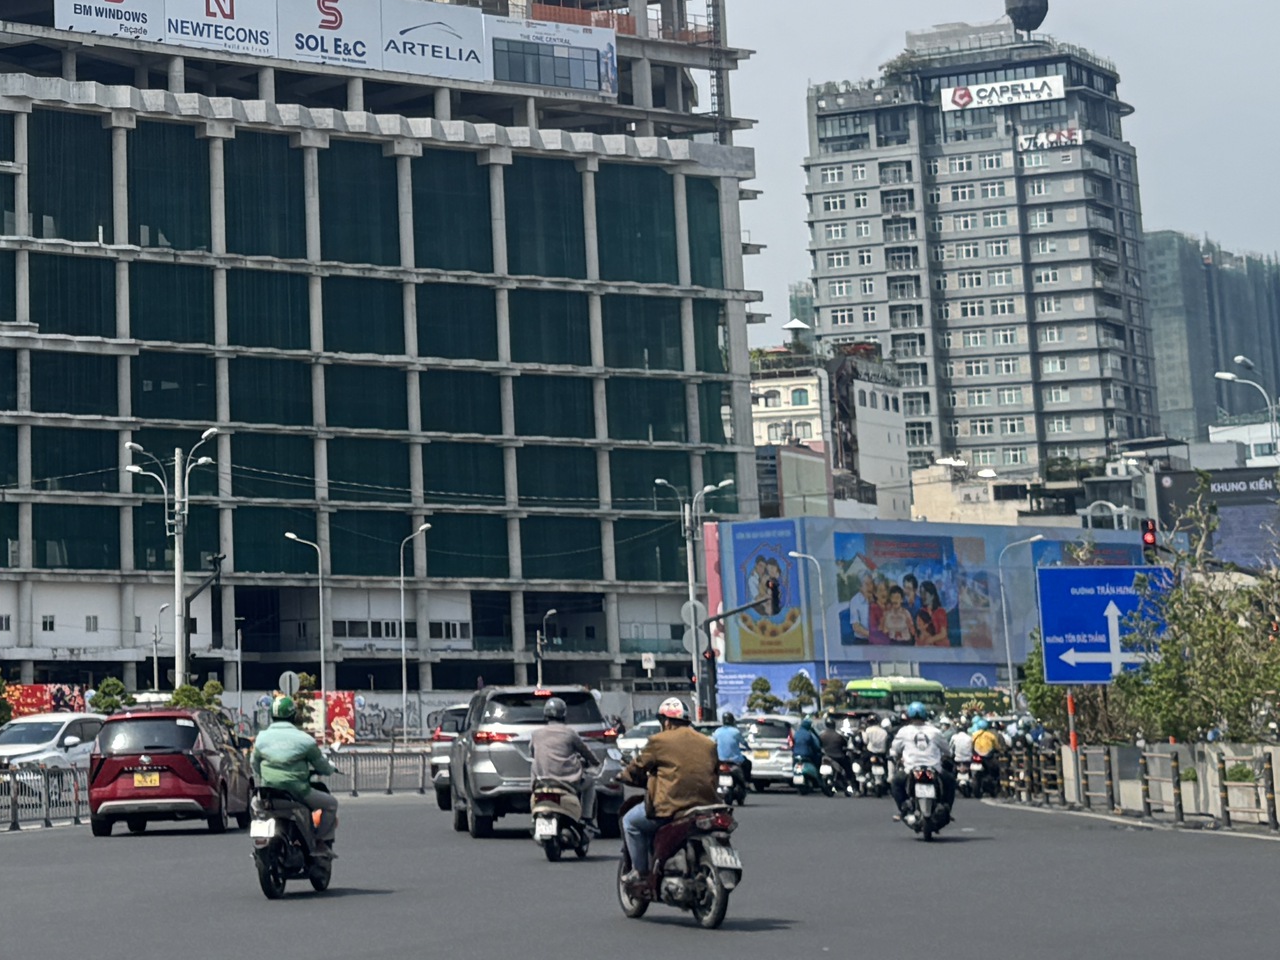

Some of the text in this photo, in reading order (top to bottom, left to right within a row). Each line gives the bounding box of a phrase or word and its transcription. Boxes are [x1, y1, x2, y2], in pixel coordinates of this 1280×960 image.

[73, 3, 148, 24] BM WINDOWS
[119, 23, 148, 36] Façade
[168, 18, 270, 46] NEWTECONS
[295, 33, 367, 58] SOL E&C
[384, 39, 481, 64] ARTELIA
[976, 80, 1052, 100] CAPELLA
[976, 92, 1053, 106] HOLDINGS
[1210, 481, 1247, 493] KHUNG
